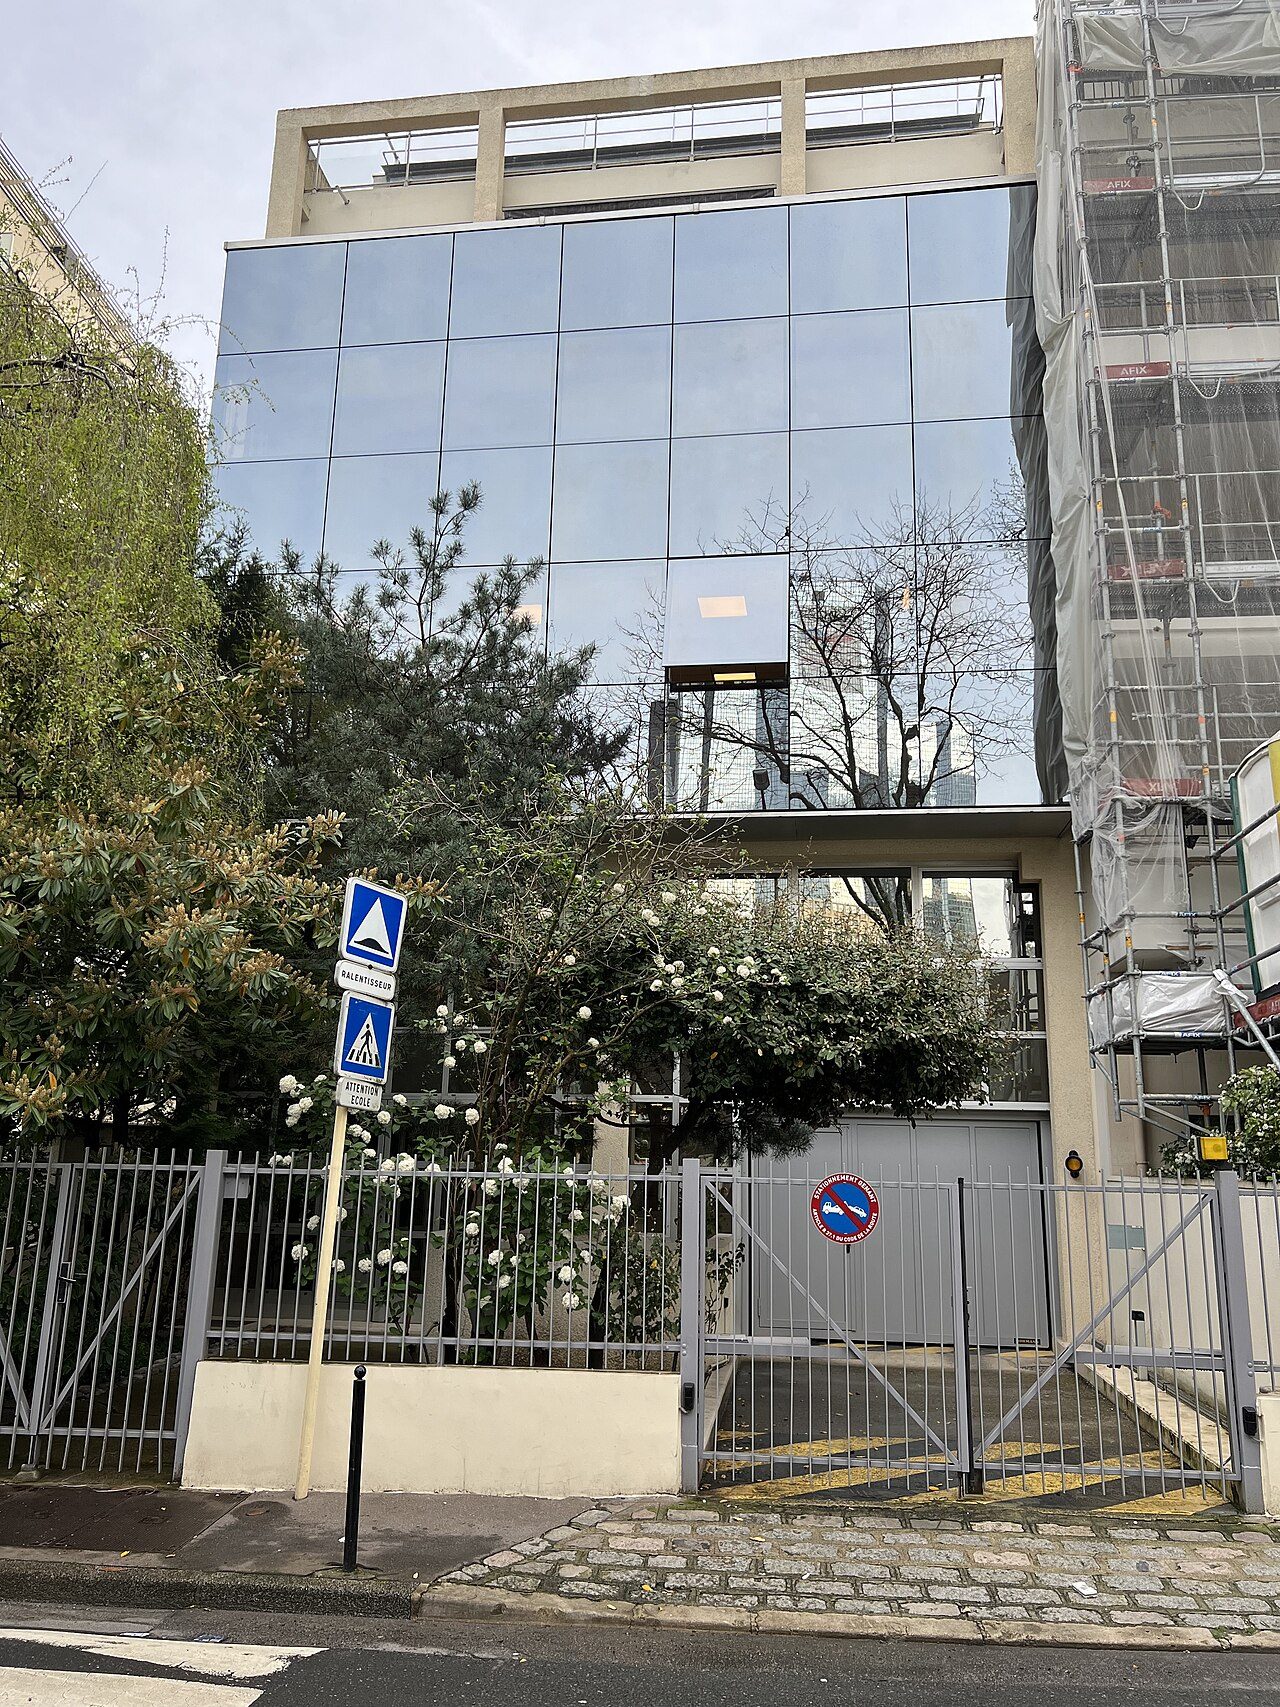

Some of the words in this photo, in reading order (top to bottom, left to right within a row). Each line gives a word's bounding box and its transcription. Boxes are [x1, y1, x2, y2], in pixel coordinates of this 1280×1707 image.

[1107, 180, 1131, 189] AFIX
[1120, 366, 1147, 376] AFIX
[341, 969, 392, 991] RALENTISSEUR
[345, 1081, 379, 1097] ATTENTION
[351, 1095, 371, 1107] ECOLE
[813, 1174, 858, 1200] STATIONNEMENT
